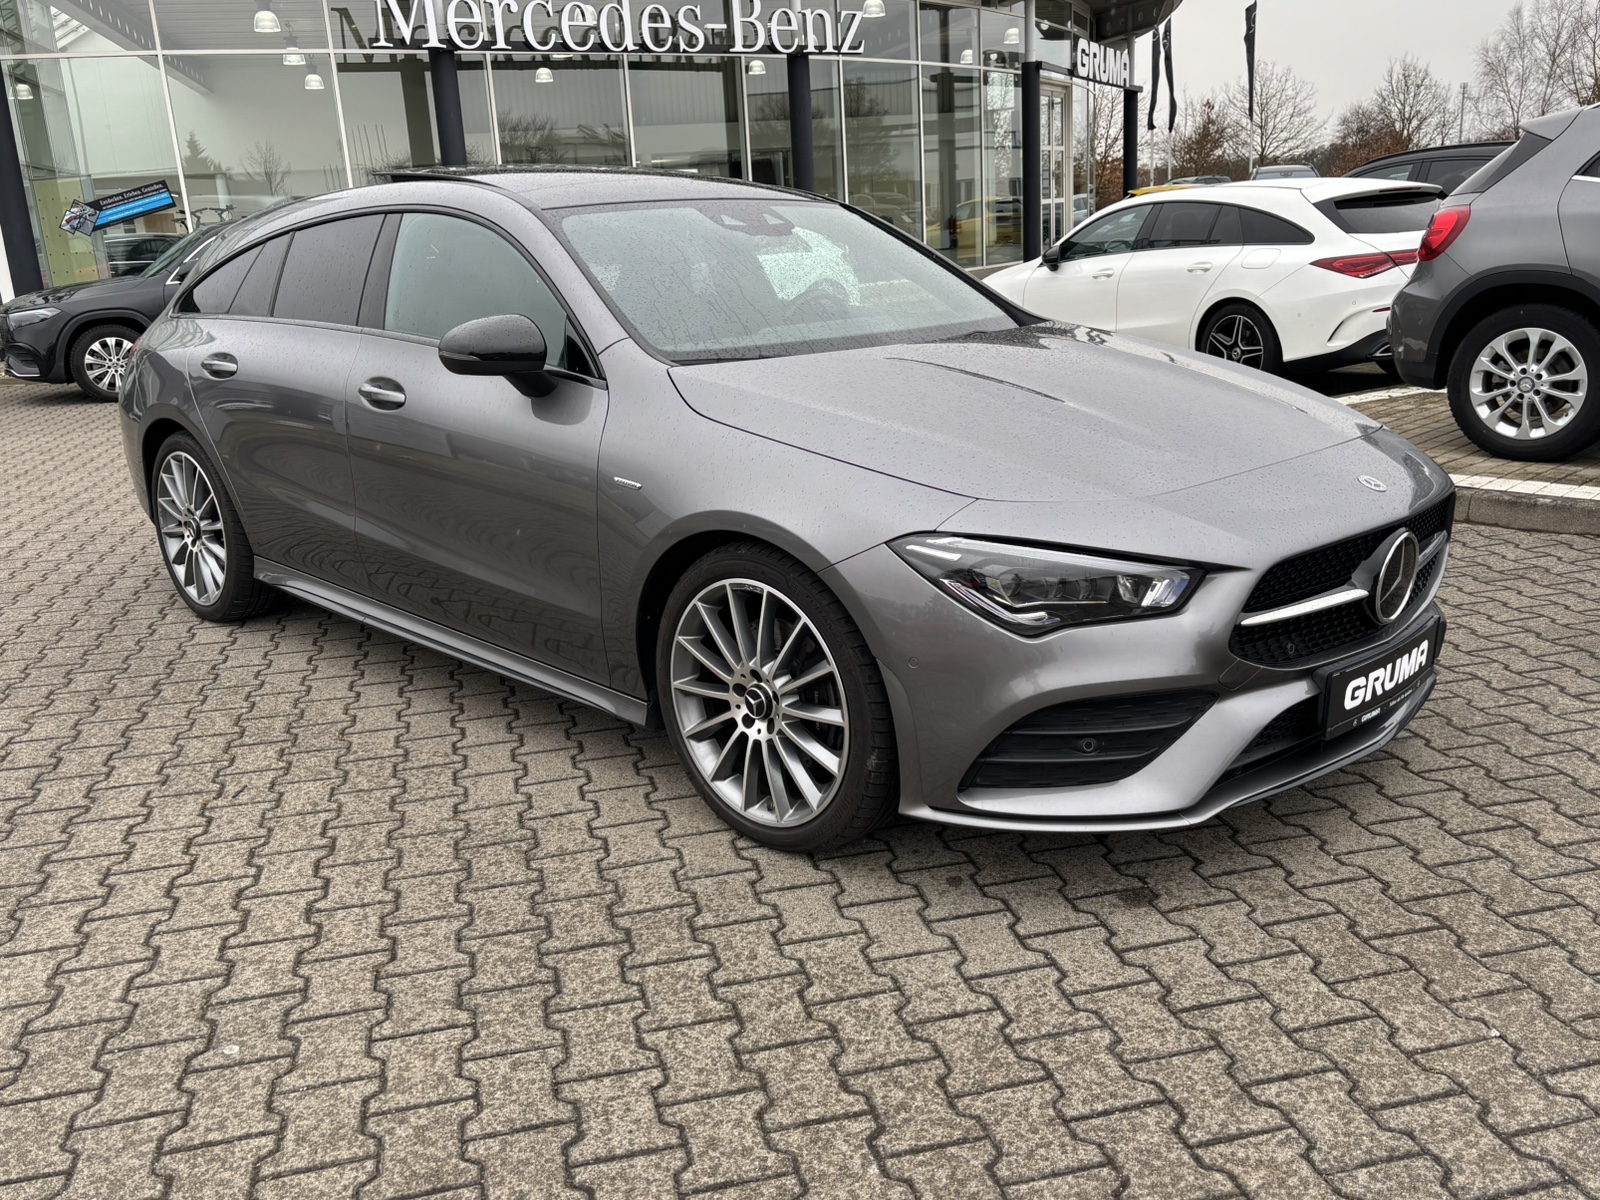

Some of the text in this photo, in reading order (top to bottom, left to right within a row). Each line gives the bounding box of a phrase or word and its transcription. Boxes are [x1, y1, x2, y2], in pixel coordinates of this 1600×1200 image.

[372, 0, 866, 54] Mercedes-Benz
[1077, 38, 1130, 87] GRUMA
[805, 592, 843, 649] TURANZA
[1344, 640, 1428, 710] GRUMA
[1361, 707, 1381, 722] GRUMA
[804, 792, 854, 843] BRIDGESTON
